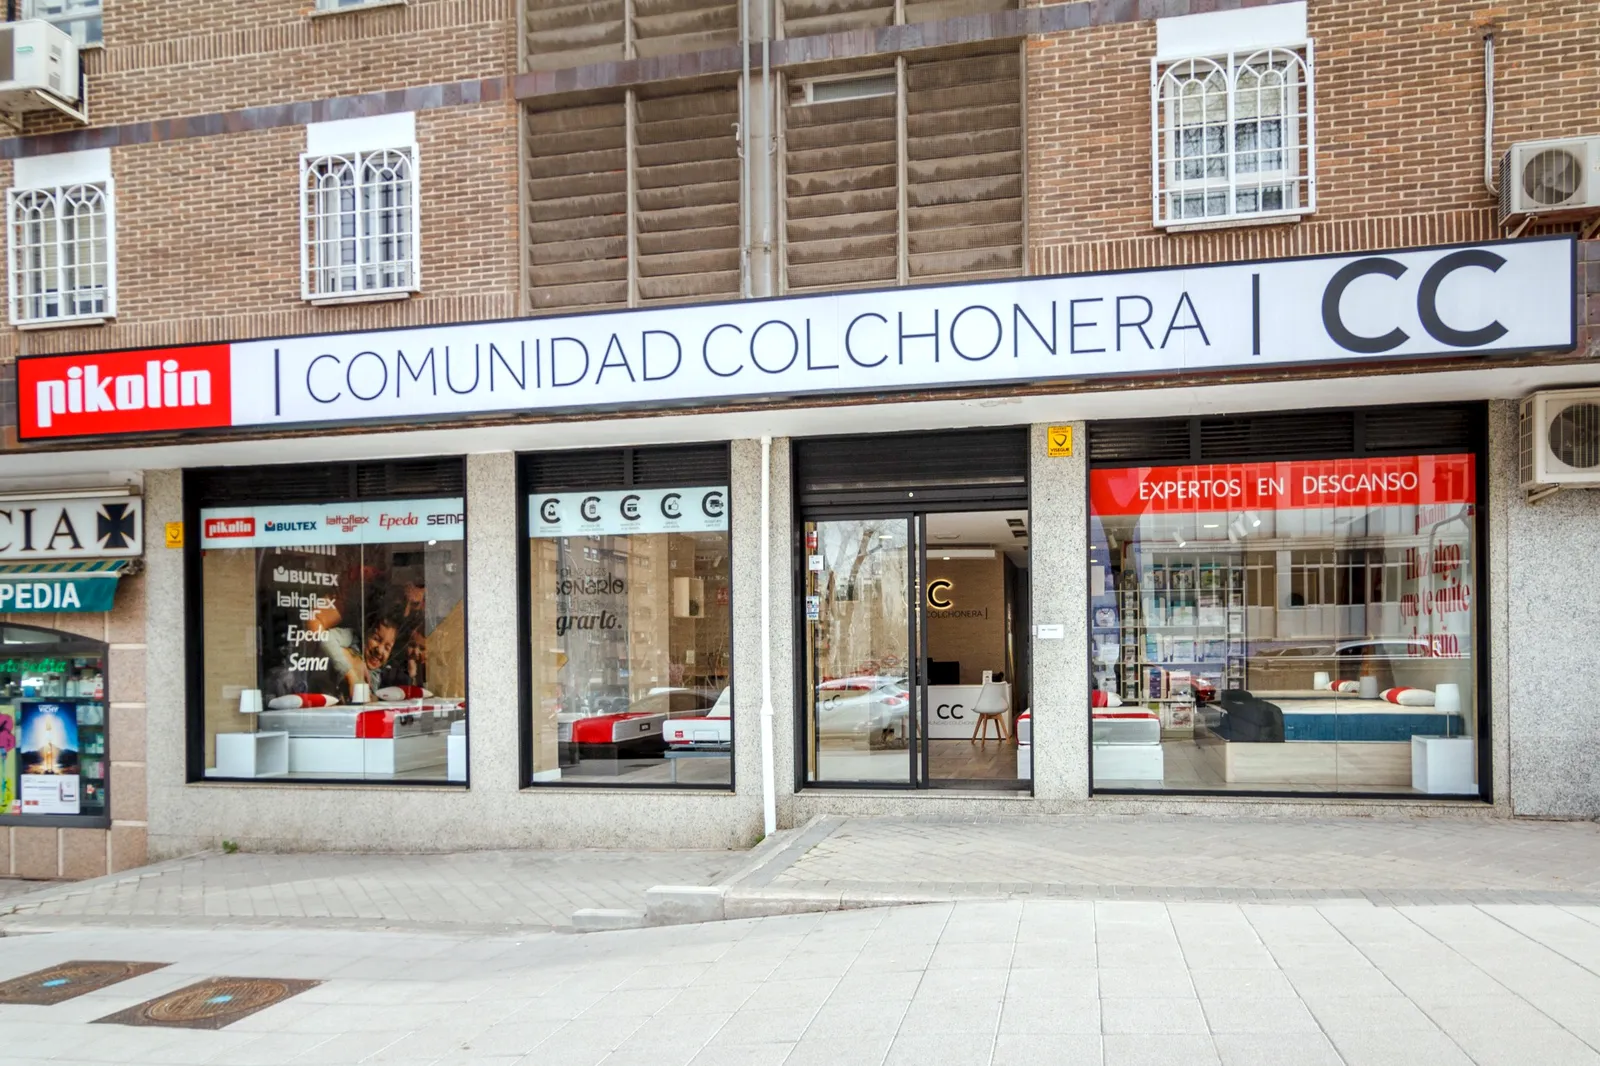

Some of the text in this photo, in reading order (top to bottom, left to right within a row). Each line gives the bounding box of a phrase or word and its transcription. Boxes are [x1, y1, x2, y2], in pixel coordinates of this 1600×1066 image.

[1321, 249, 1509, 354] CC
[306, 291, 1211, 404] COMUNIDAD COLCHONERA
[36, 359, 212, 428] pikolin
[1139, 471, 1418, 500] EXPERTOS EN DESCANSO
[208, 520, 252, 537] pikolin
[276, 521, 317, 532] BULTEX
[326, 514, 369, 526] lattoflex
[342, 523, 357, 532] air
[379, 512, 418, 530] Epeda
[1432, 539, 1460, 581] algo
[290, 570, 339, 586] BULTEX
[0, 582, 81, 609] PEDIA
[277, 590, 336, 609] lattoflex
[1401, 577, 1470, 625] que te quite
[299, 608, 320, 620] air
[287, 624, 330, 647] Epeda
[288, 652, 330, 671] Sema
[936, 704, 964, 719] CC
